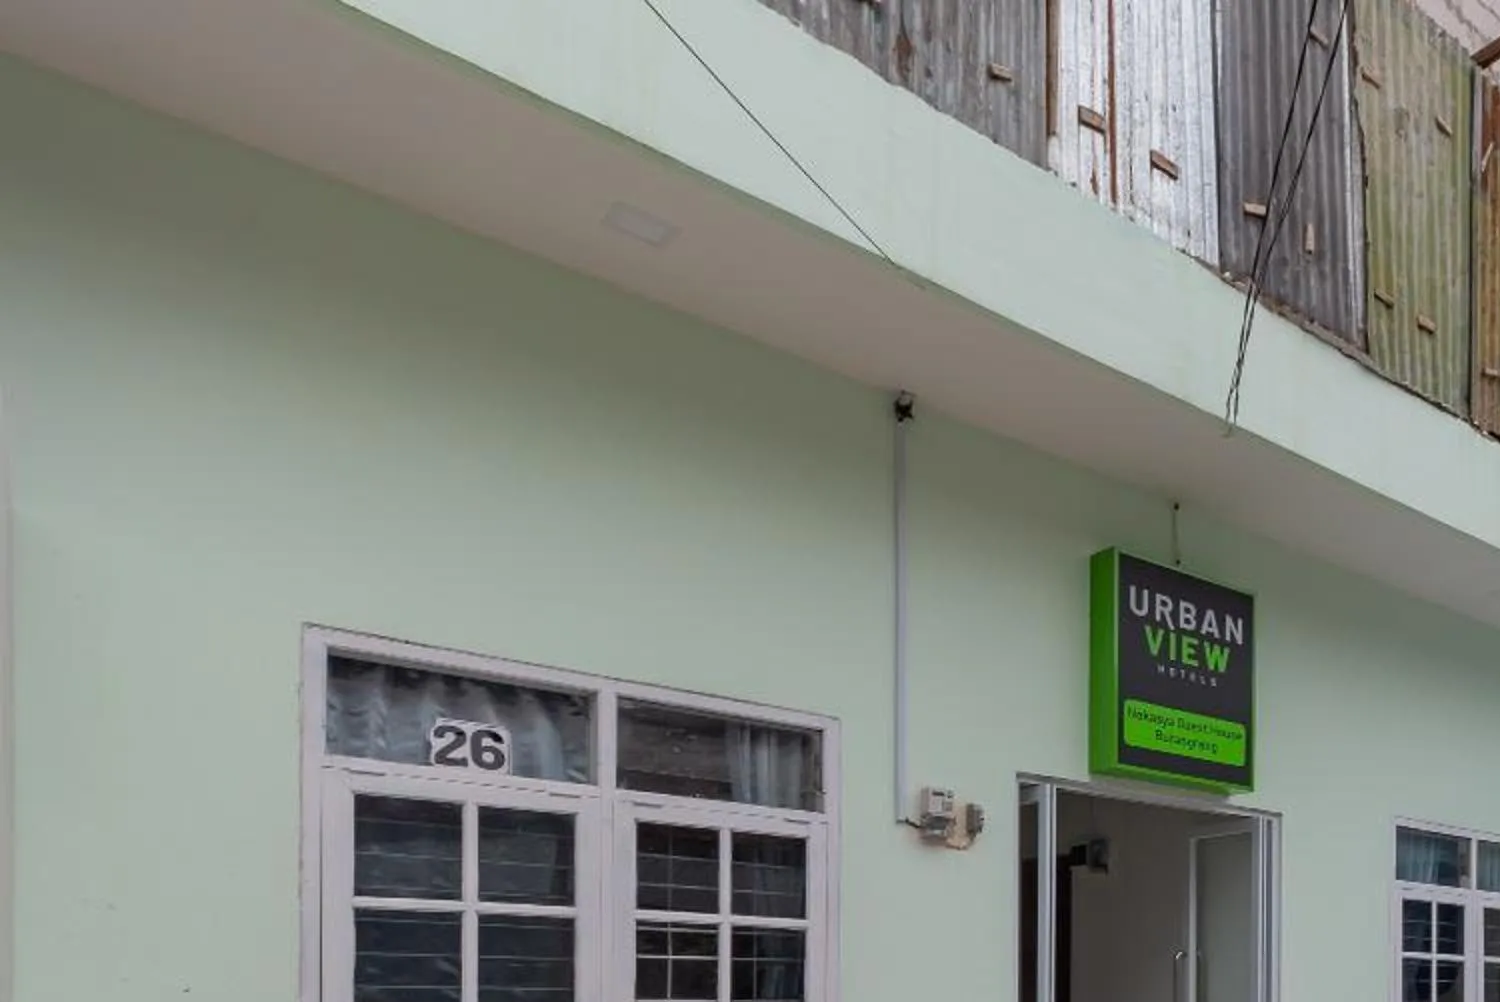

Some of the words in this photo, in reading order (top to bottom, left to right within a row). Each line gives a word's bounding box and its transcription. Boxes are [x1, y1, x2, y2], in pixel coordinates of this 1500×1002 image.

[1129, 585, 1243, 645] URBAN
[1144, 624, 1230, 673] VIEW
[433, 725, 505, 770] 26
